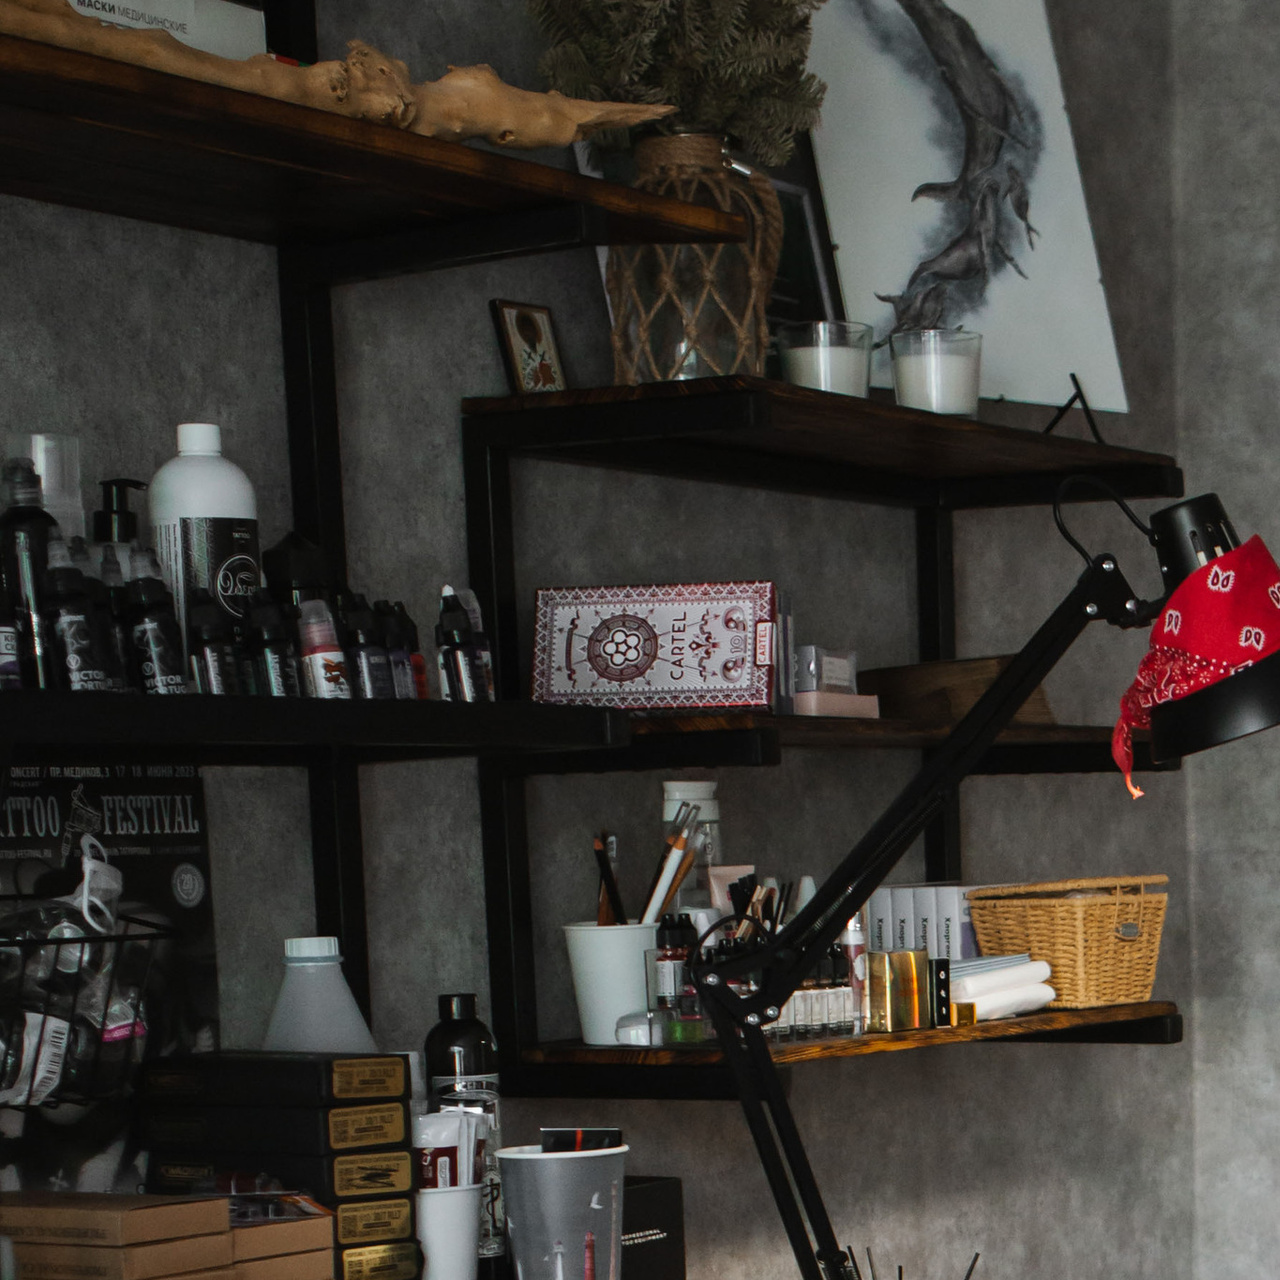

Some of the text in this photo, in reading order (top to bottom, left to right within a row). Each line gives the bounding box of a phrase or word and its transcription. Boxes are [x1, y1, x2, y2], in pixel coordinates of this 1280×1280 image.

[77, 0, 187, 34] МАСКИ МЕДИЦИНСКИЕ
[670, 611, 688, 681] CARTEL
[757, 625, 767, 663] CARTEL
[115, 765, 125, 778] 17
[0, 795, 200, 838] TTOO FESTIVAL
